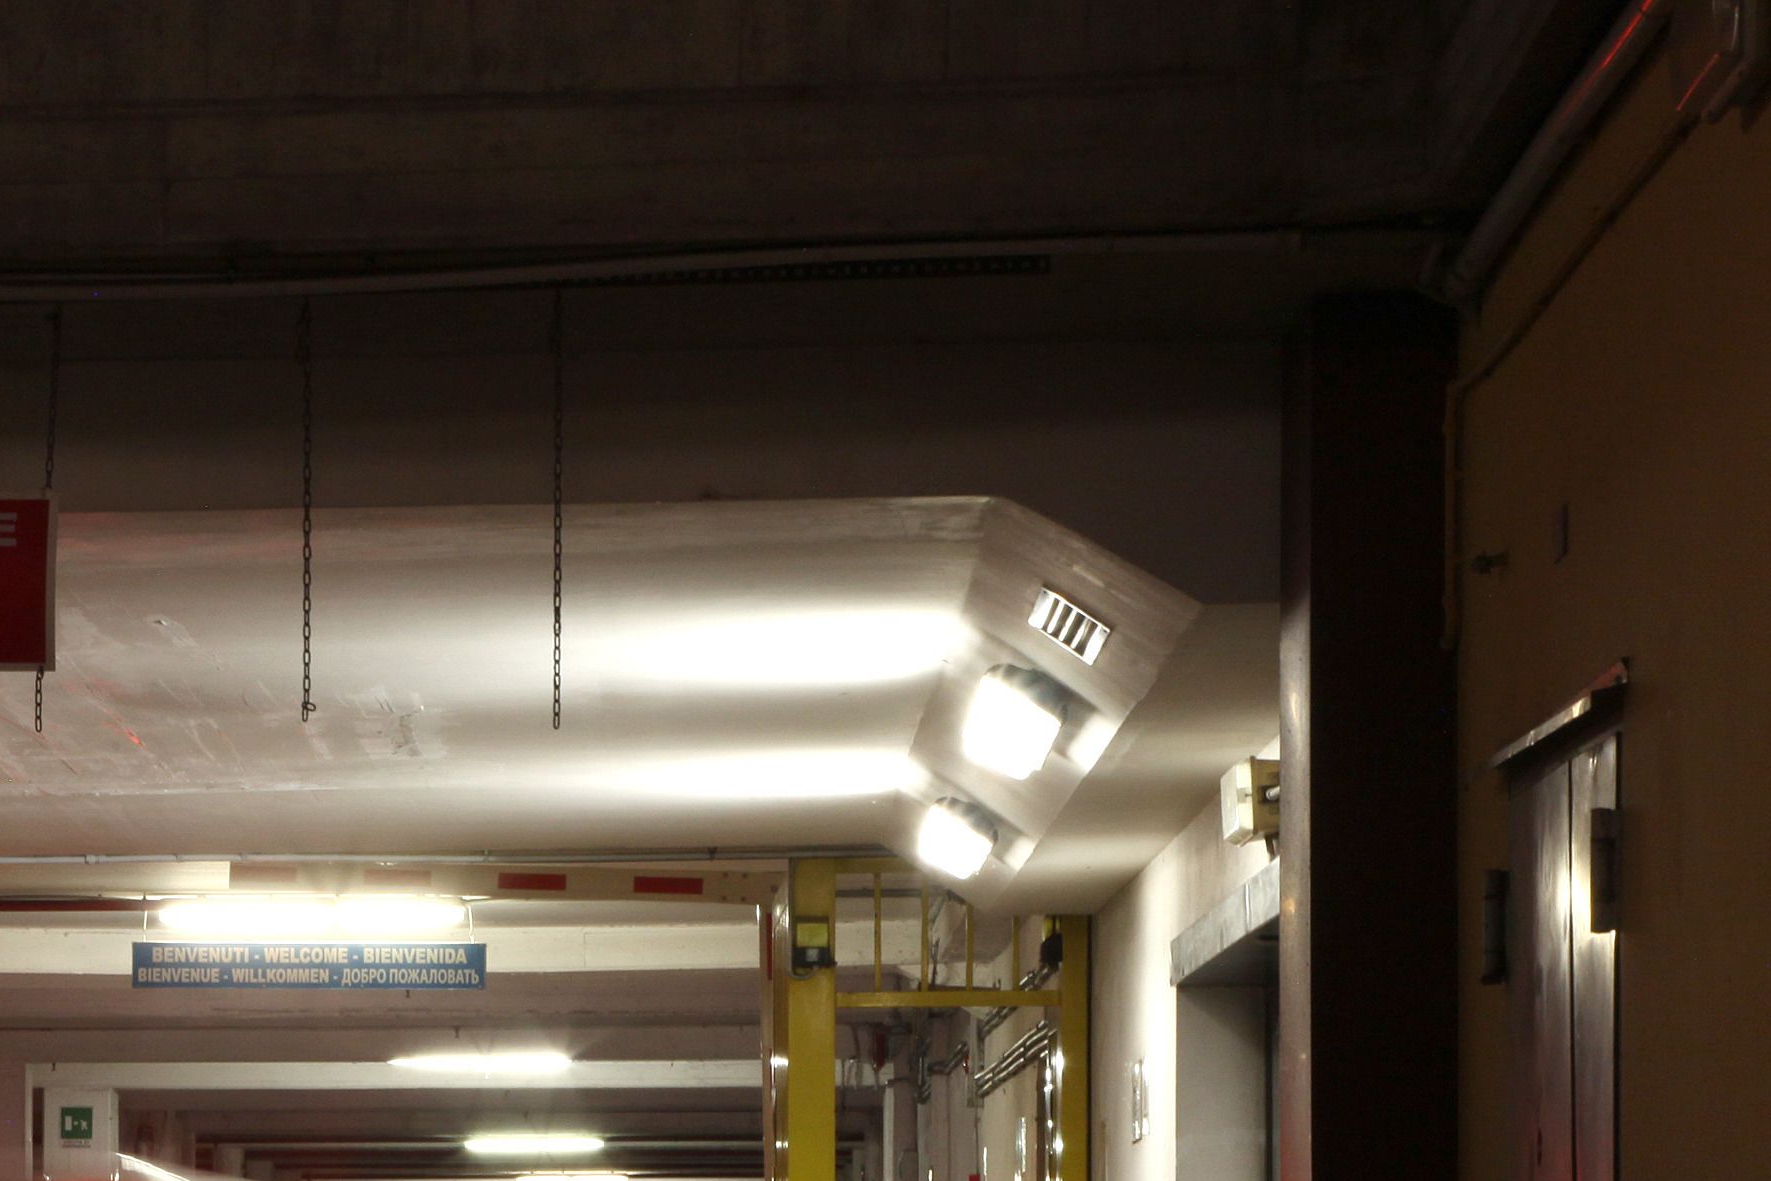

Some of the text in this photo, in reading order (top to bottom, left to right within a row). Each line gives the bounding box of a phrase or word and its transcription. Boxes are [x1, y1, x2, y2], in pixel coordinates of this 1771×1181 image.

[152, 946, 250, 964] BENVENUTI
[264, 946, 349, 965] WELCOME
[363, 947, 468, 965] BIENVENIDA
[137, 967, 220, 984] BIENVENUE
[231, 967, 329, 984] WILLKOMMEN
[341, 968, 386, 987] ДОБРО
[389, 968, 479, 985] ПОЖАЛОВАТЬ
